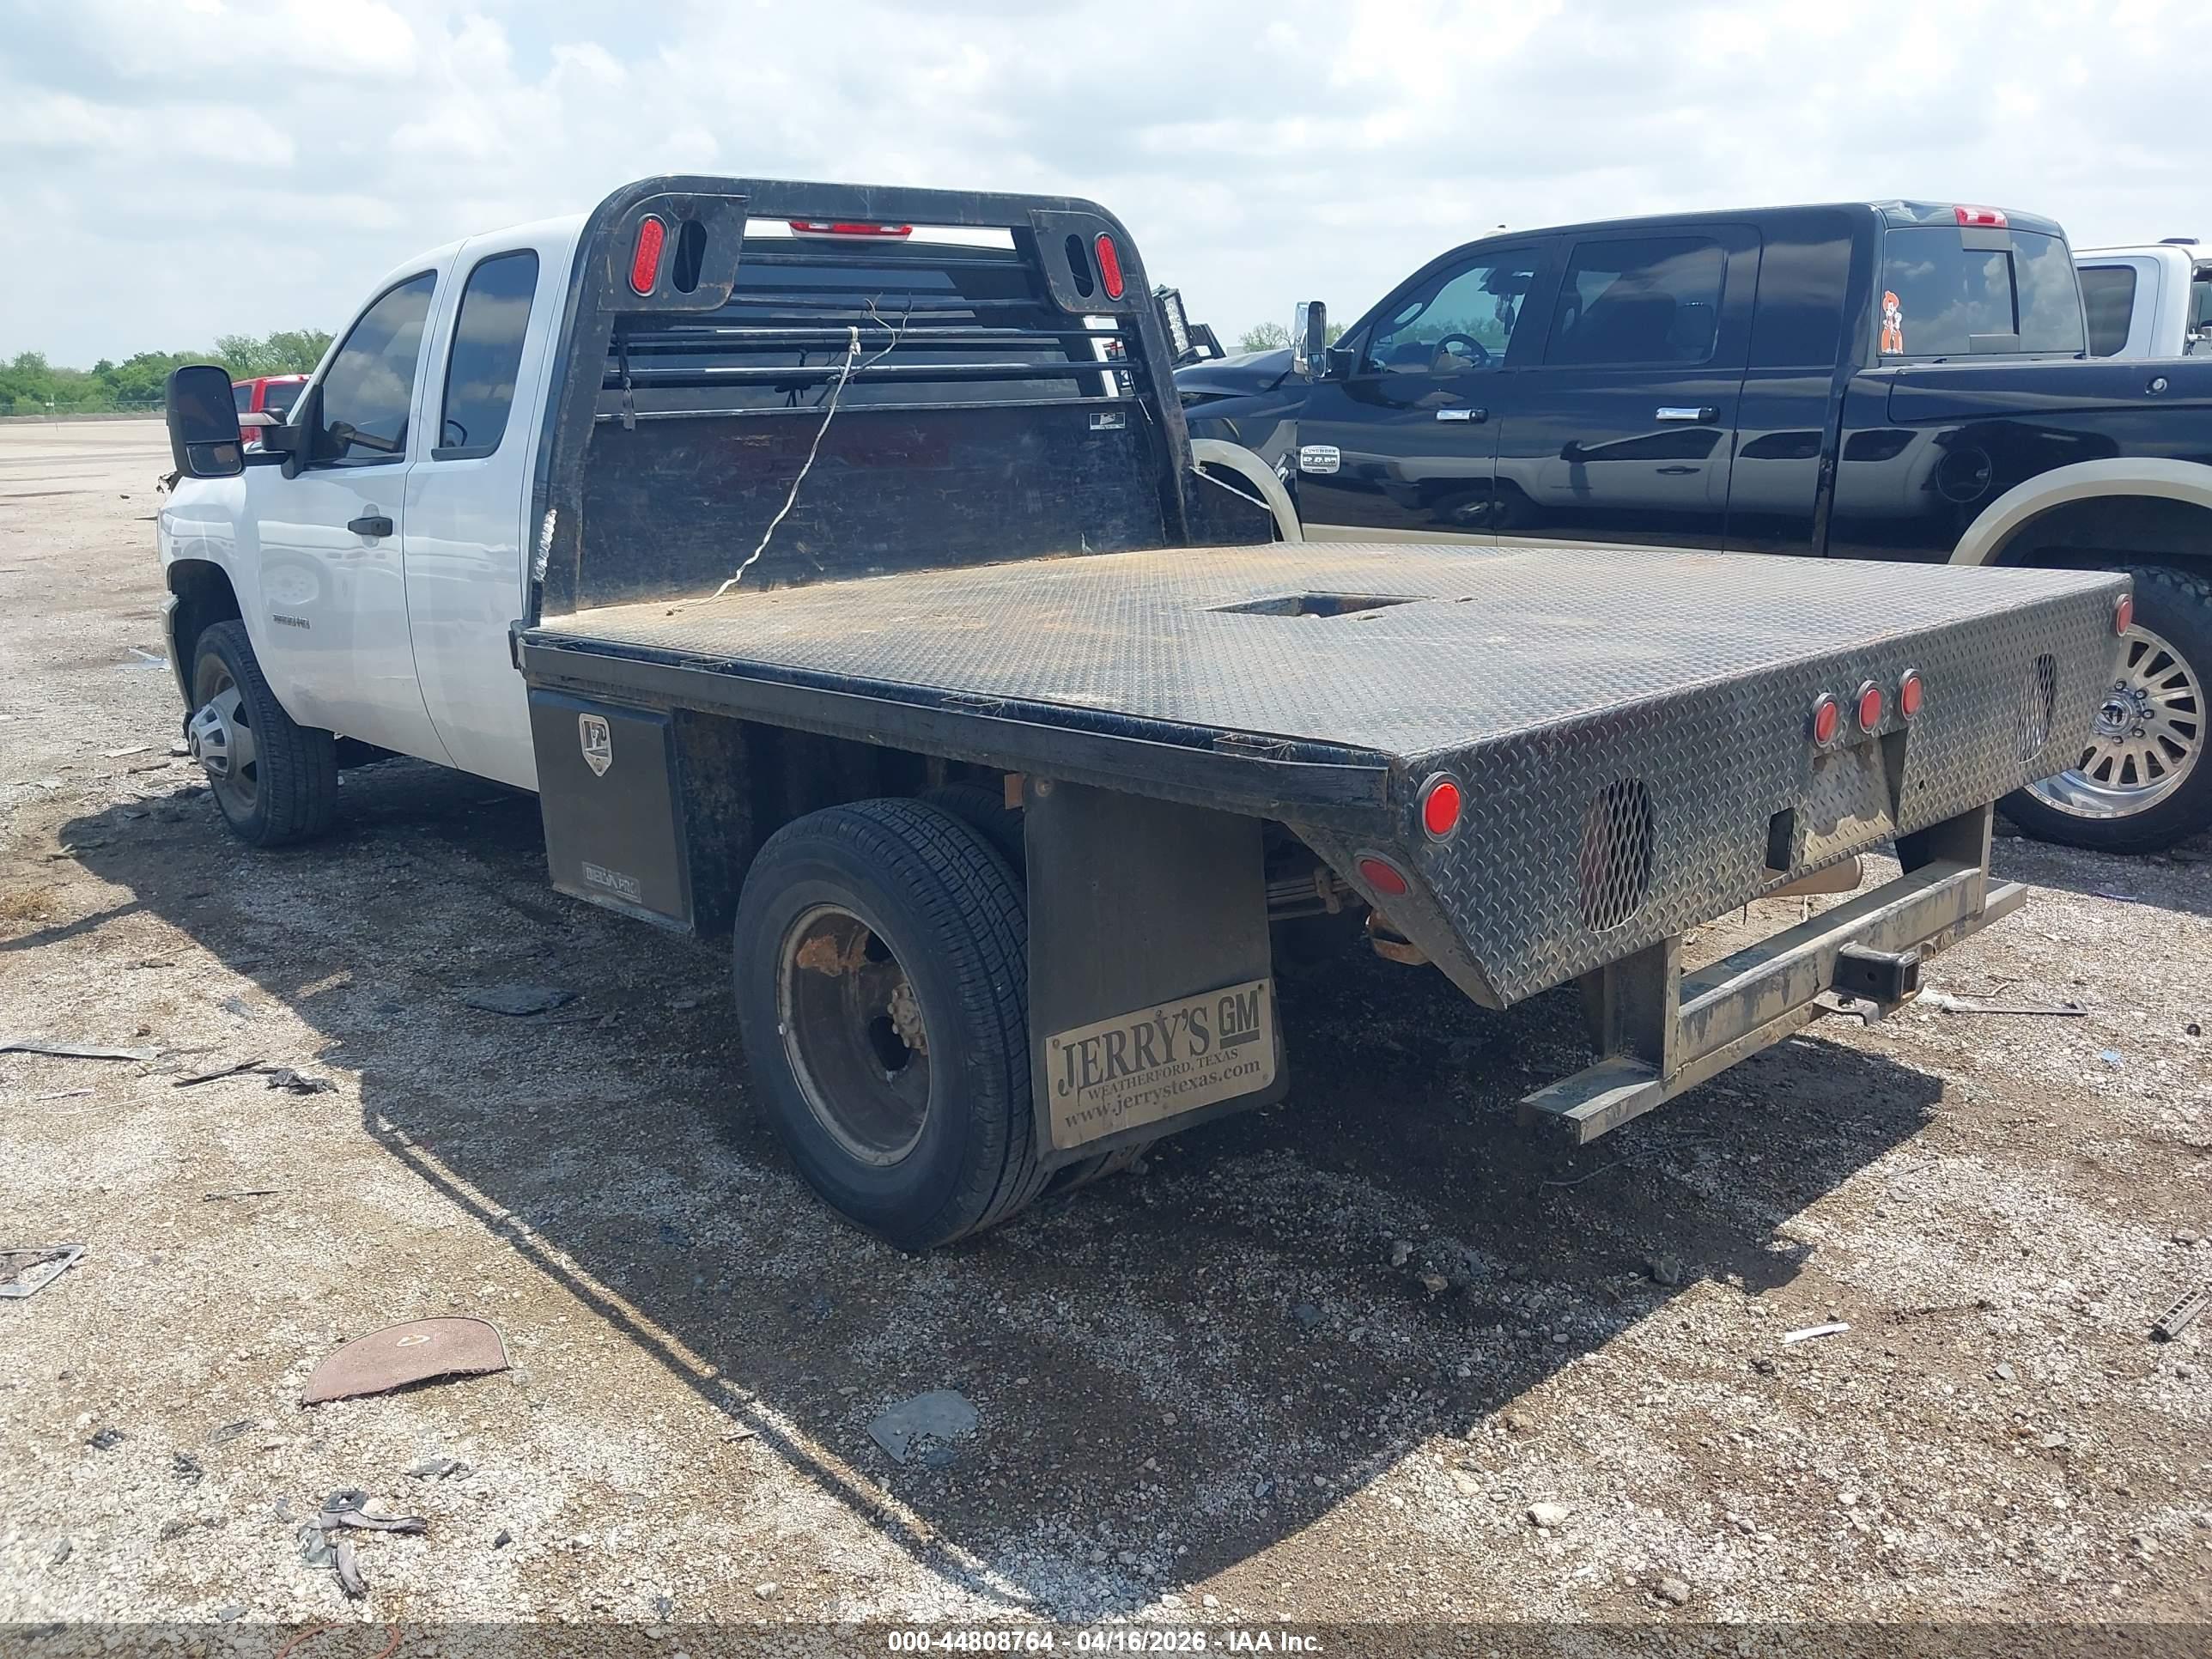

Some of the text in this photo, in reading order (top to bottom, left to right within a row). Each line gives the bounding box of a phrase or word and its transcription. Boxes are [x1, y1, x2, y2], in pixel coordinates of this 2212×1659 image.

[1058, 990, 1260, 1097] JERRY'S GM
[1087, 1048, 1238, 1101] WEATHERFORD, TEXAS
[1065, 1060, 1261, 1128] www.jerrystexas.com
